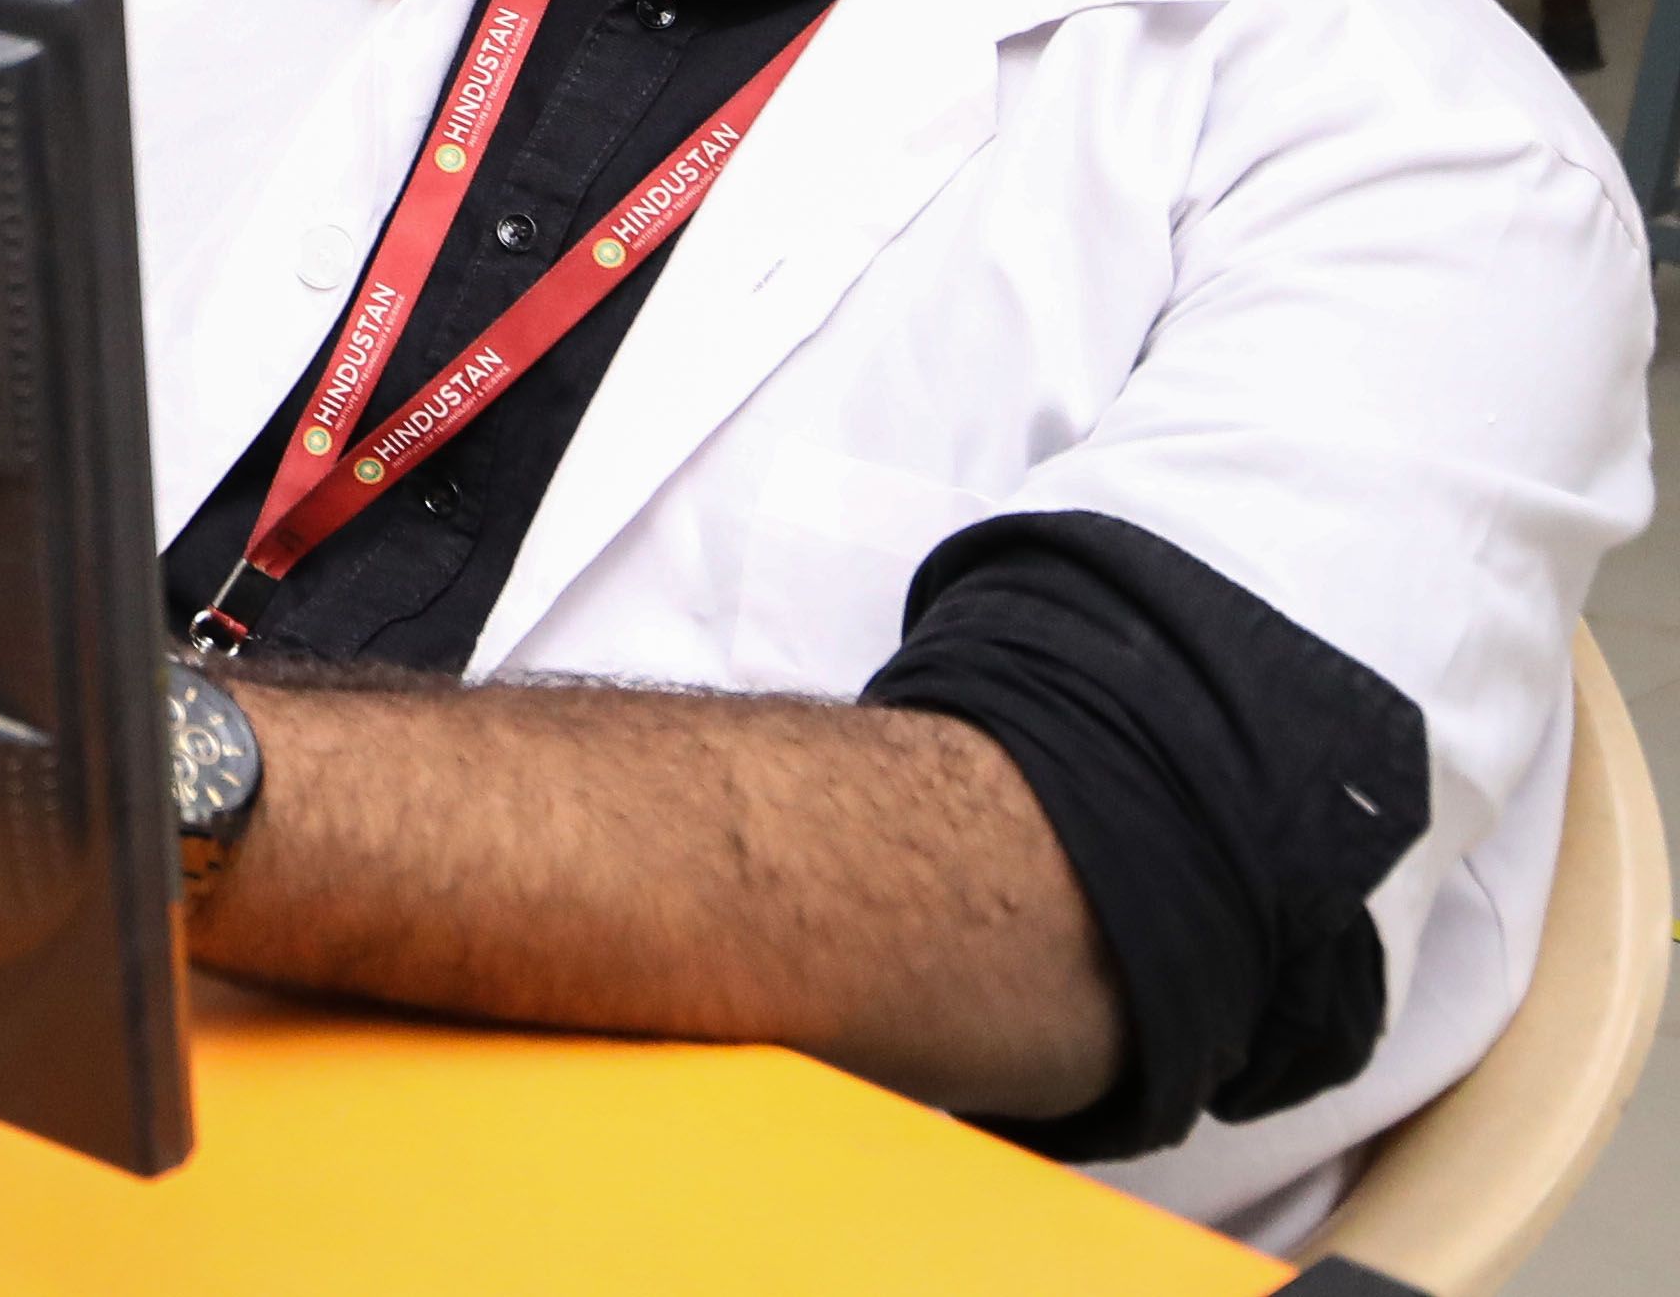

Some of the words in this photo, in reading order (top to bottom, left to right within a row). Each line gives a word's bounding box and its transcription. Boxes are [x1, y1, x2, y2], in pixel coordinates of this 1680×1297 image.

[442, 7, 521, 145] HINDUSTAN
[610, 121, 741, 244] HINDUSTAN
[631, 218, 666, 253] INSTITUTE
[662, 209, 674, 222] OF
[313, 281, 398, 427] HINDUSTAN
[334, 392, 360, 432] INSTITUTE
[353, 383, 365, 396] OF
[373, 346, 504, 462] HINDUSTAN
